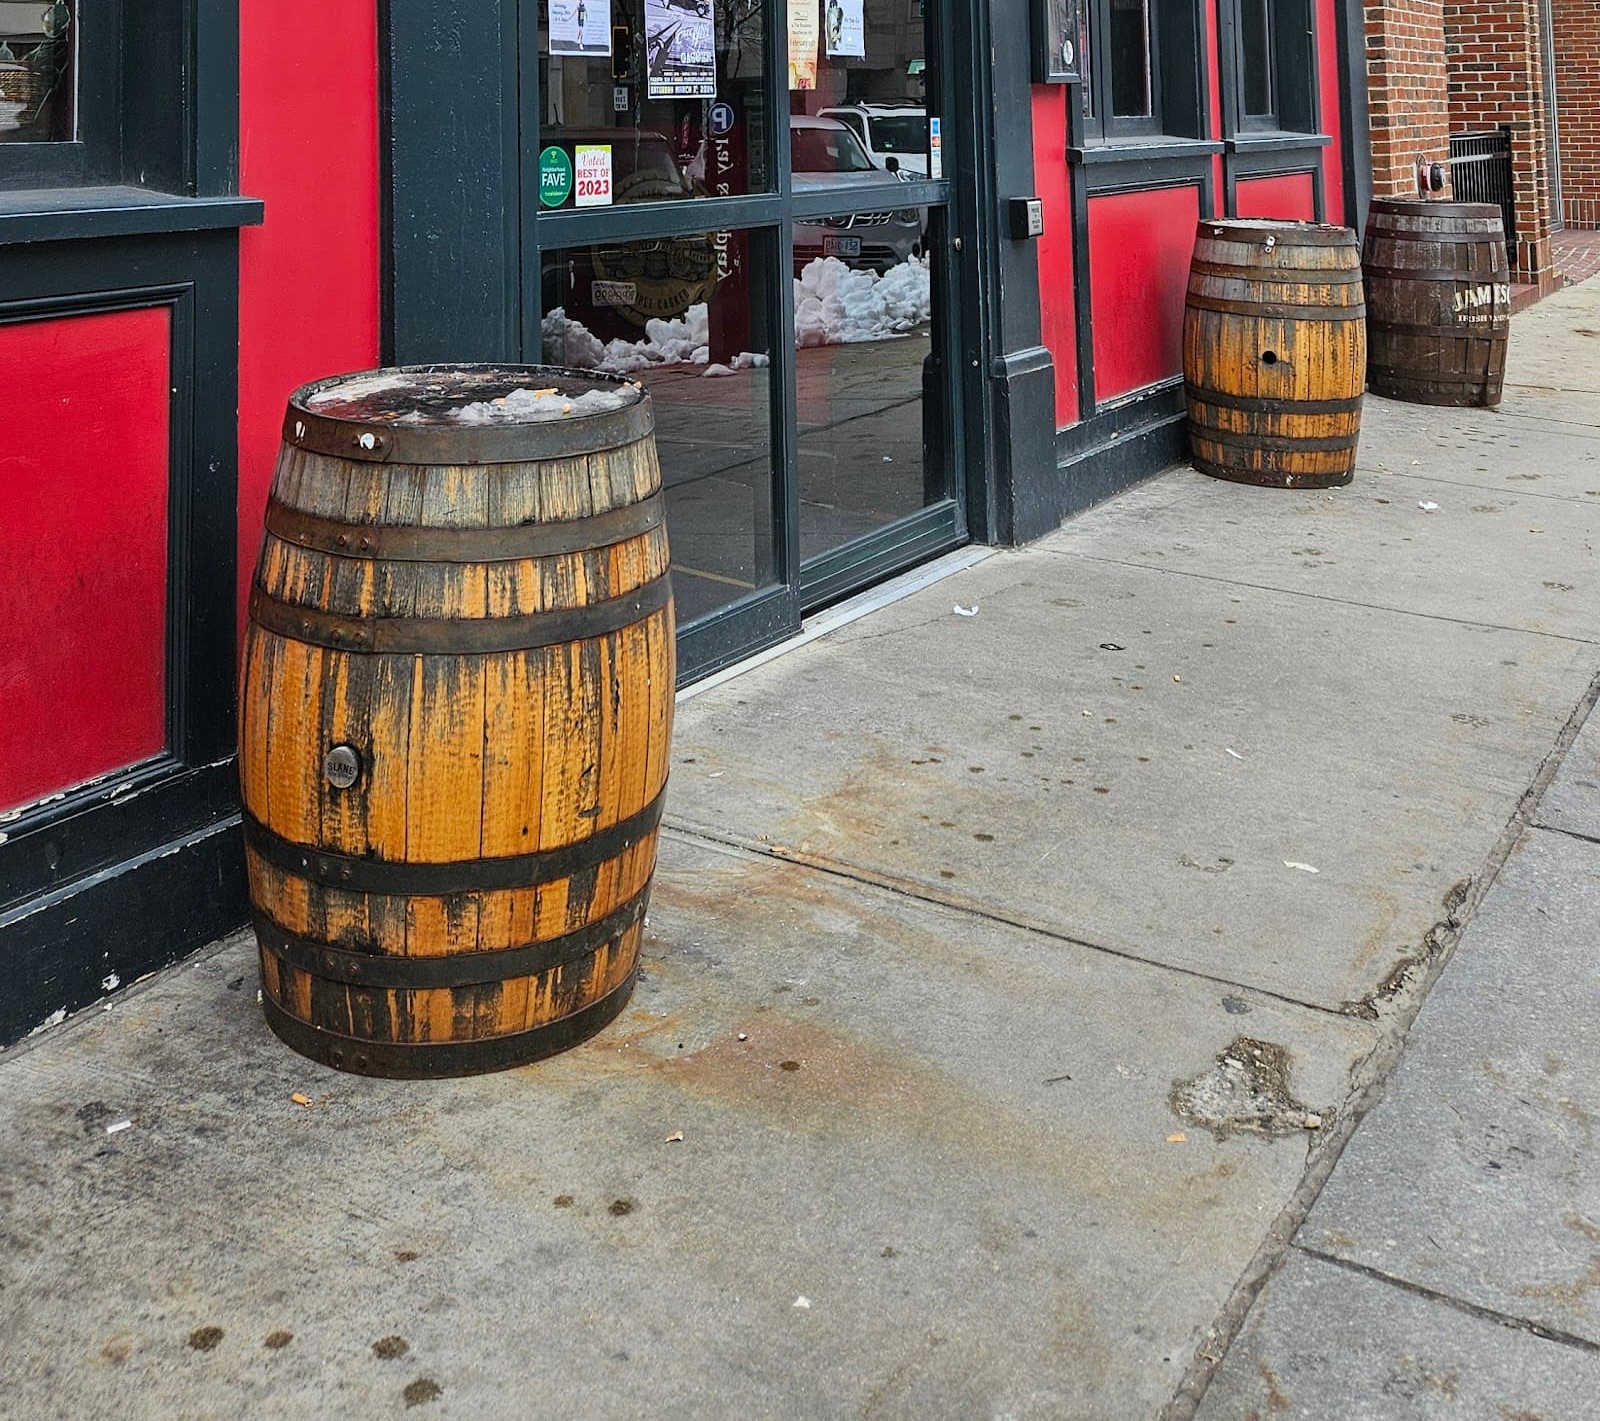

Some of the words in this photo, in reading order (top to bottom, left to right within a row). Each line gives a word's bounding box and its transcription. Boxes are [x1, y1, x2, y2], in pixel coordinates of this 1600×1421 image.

[582, 153, 606, 167] Voted
[542, 173, 566, 188] FAVE
[578, 169, 598, 179] BEST
[600, 168, 609, 178] OF
[578, 180, 610, 196] 2023
[1458, 314, 1488, 323] IRISH
[327, 761, 353, 776] SLANE
